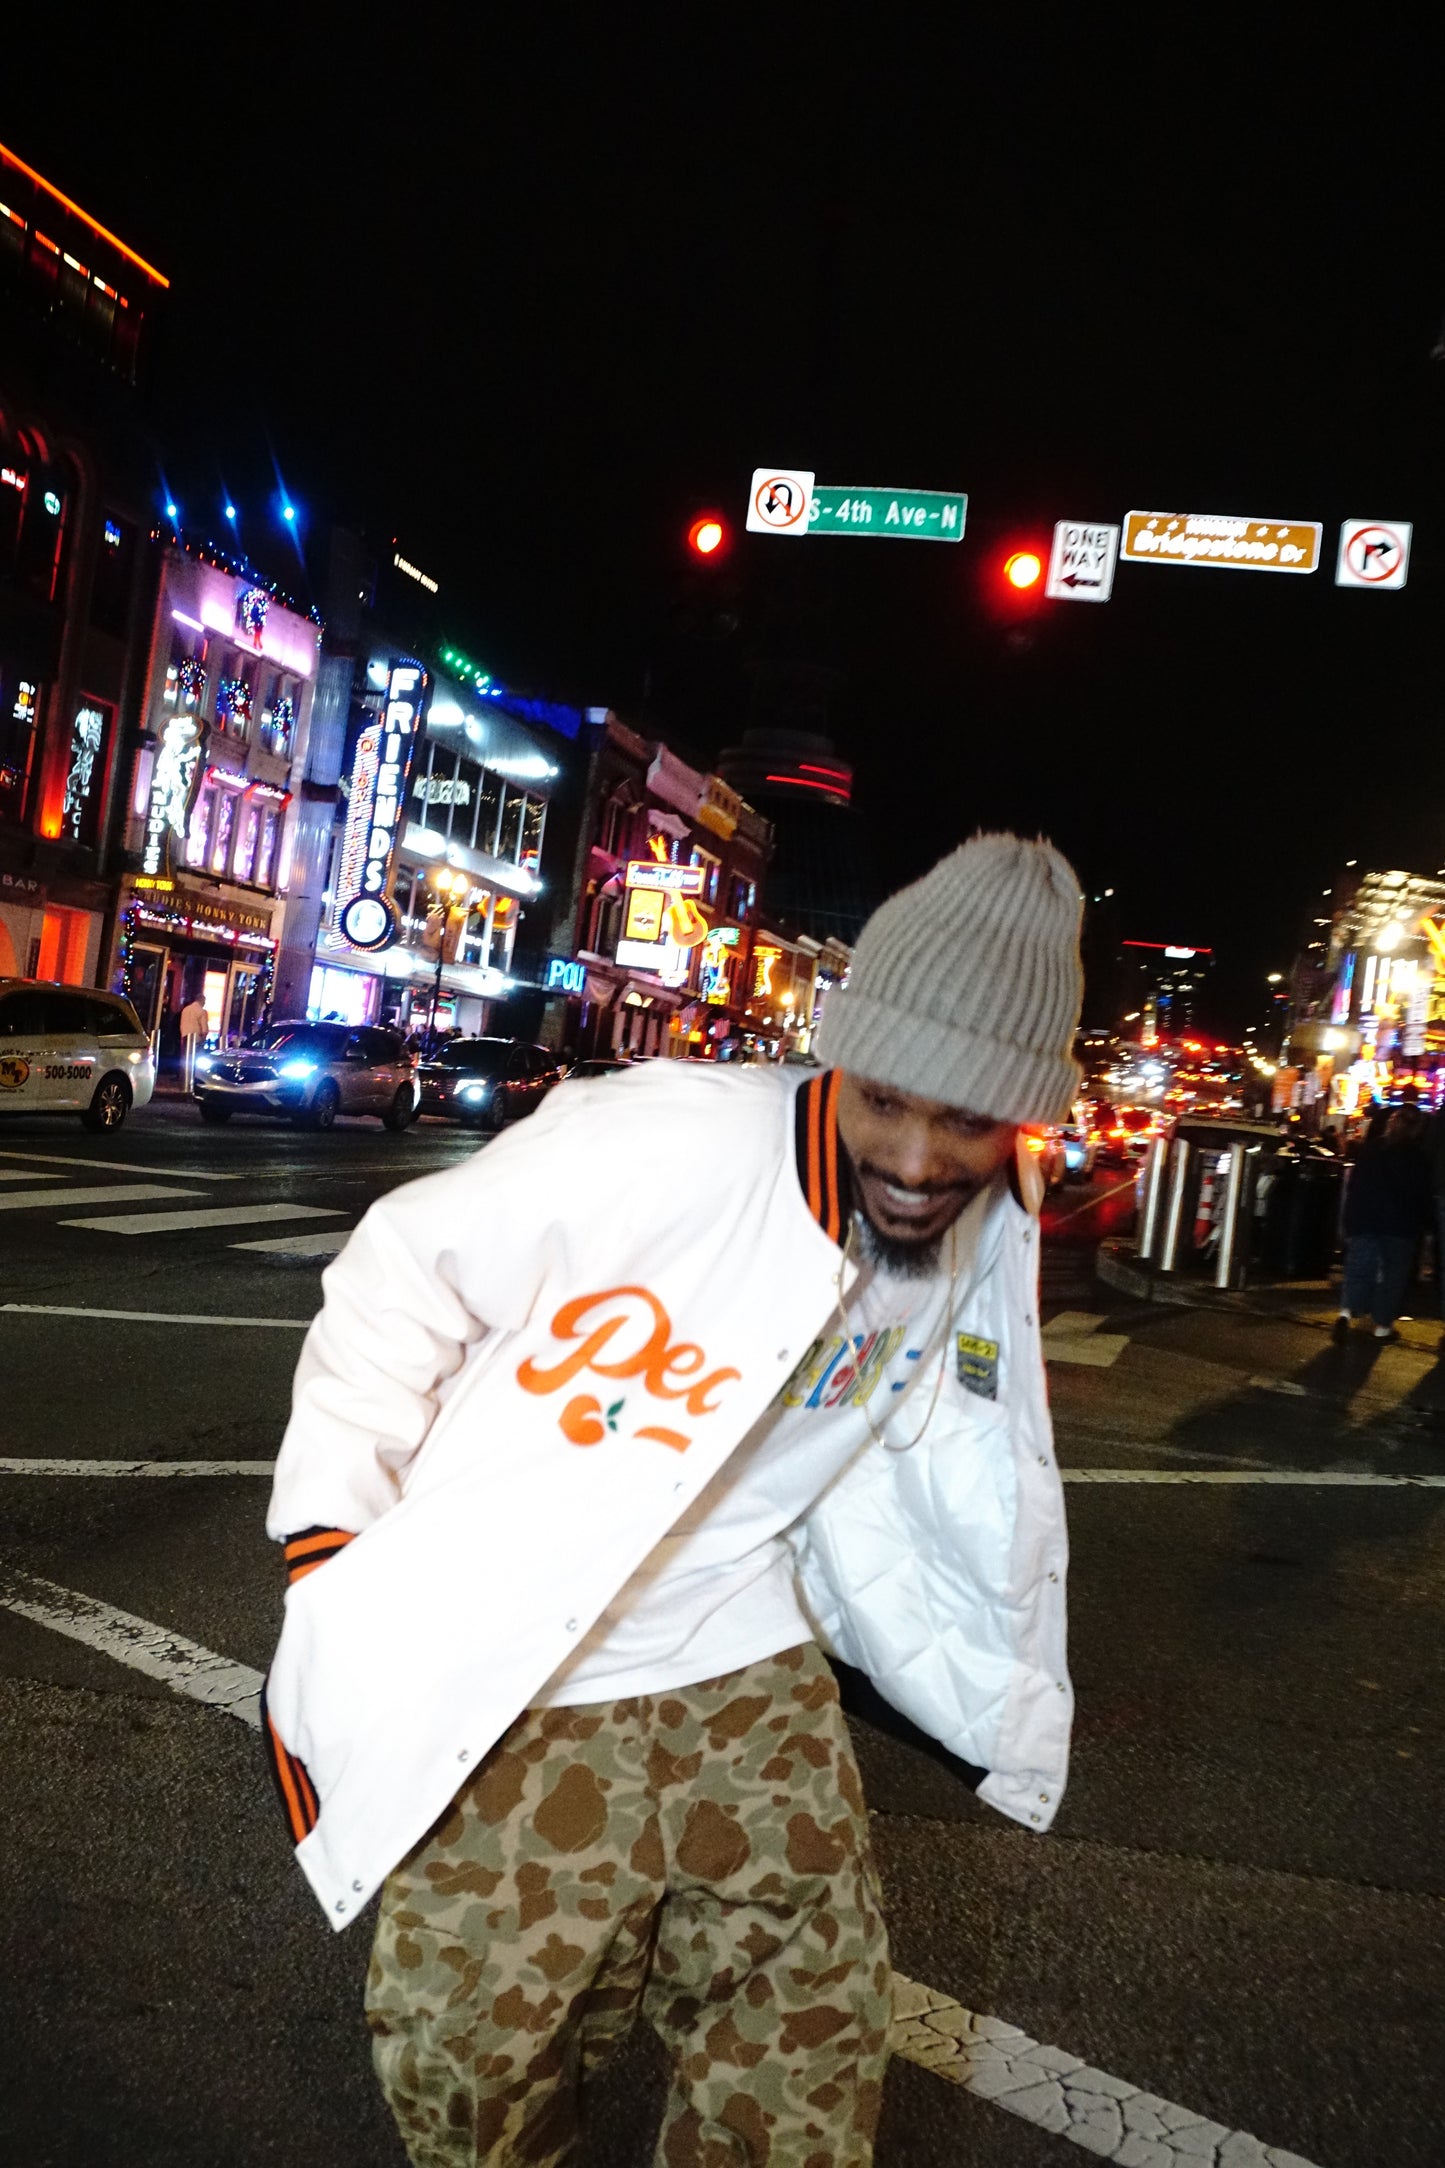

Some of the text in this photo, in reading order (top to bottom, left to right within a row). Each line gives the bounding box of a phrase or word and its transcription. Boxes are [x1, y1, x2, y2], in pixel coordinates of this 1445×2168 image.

[1065, 528, 1110, 549] ONE
[1133, 529, 1307, 563] Bridgestone Dr
[1063, 549, 1107, 570] WAY
[364, 667, 420, 893] FRIENDS
[143, 791, 167, 875] NUDIES
[3, 874, 38, 892] BAR
[196, 903, 235, 922] HONKY
[239, 913, 267, 929] TONK
[44, 1065, 92, 1080] 500-5000
